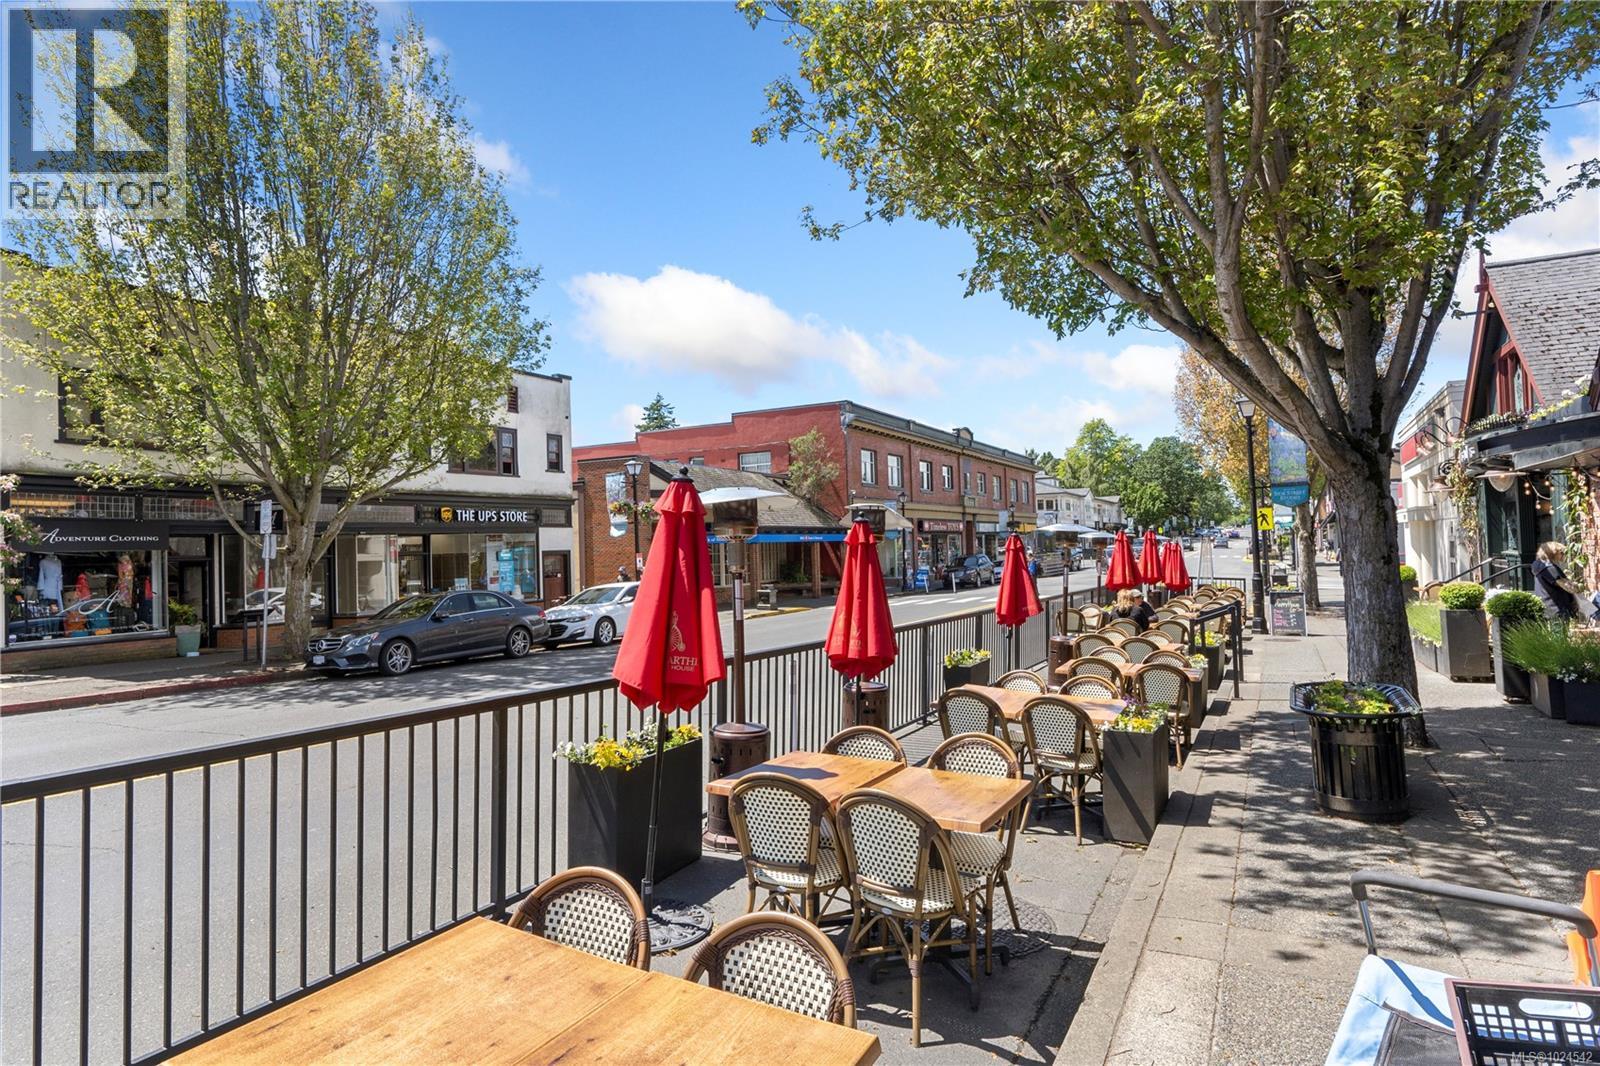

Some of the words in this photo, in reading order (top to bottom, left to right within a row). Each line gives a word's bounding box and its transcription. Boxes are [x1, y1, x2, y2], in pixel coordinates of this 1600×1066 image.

[456, 509, 475, 521] THE
[478, 510, 497, 522] UPS
[500, 511, 528, 522] STORE
[109, 534, 159, 542] CLOTHING
